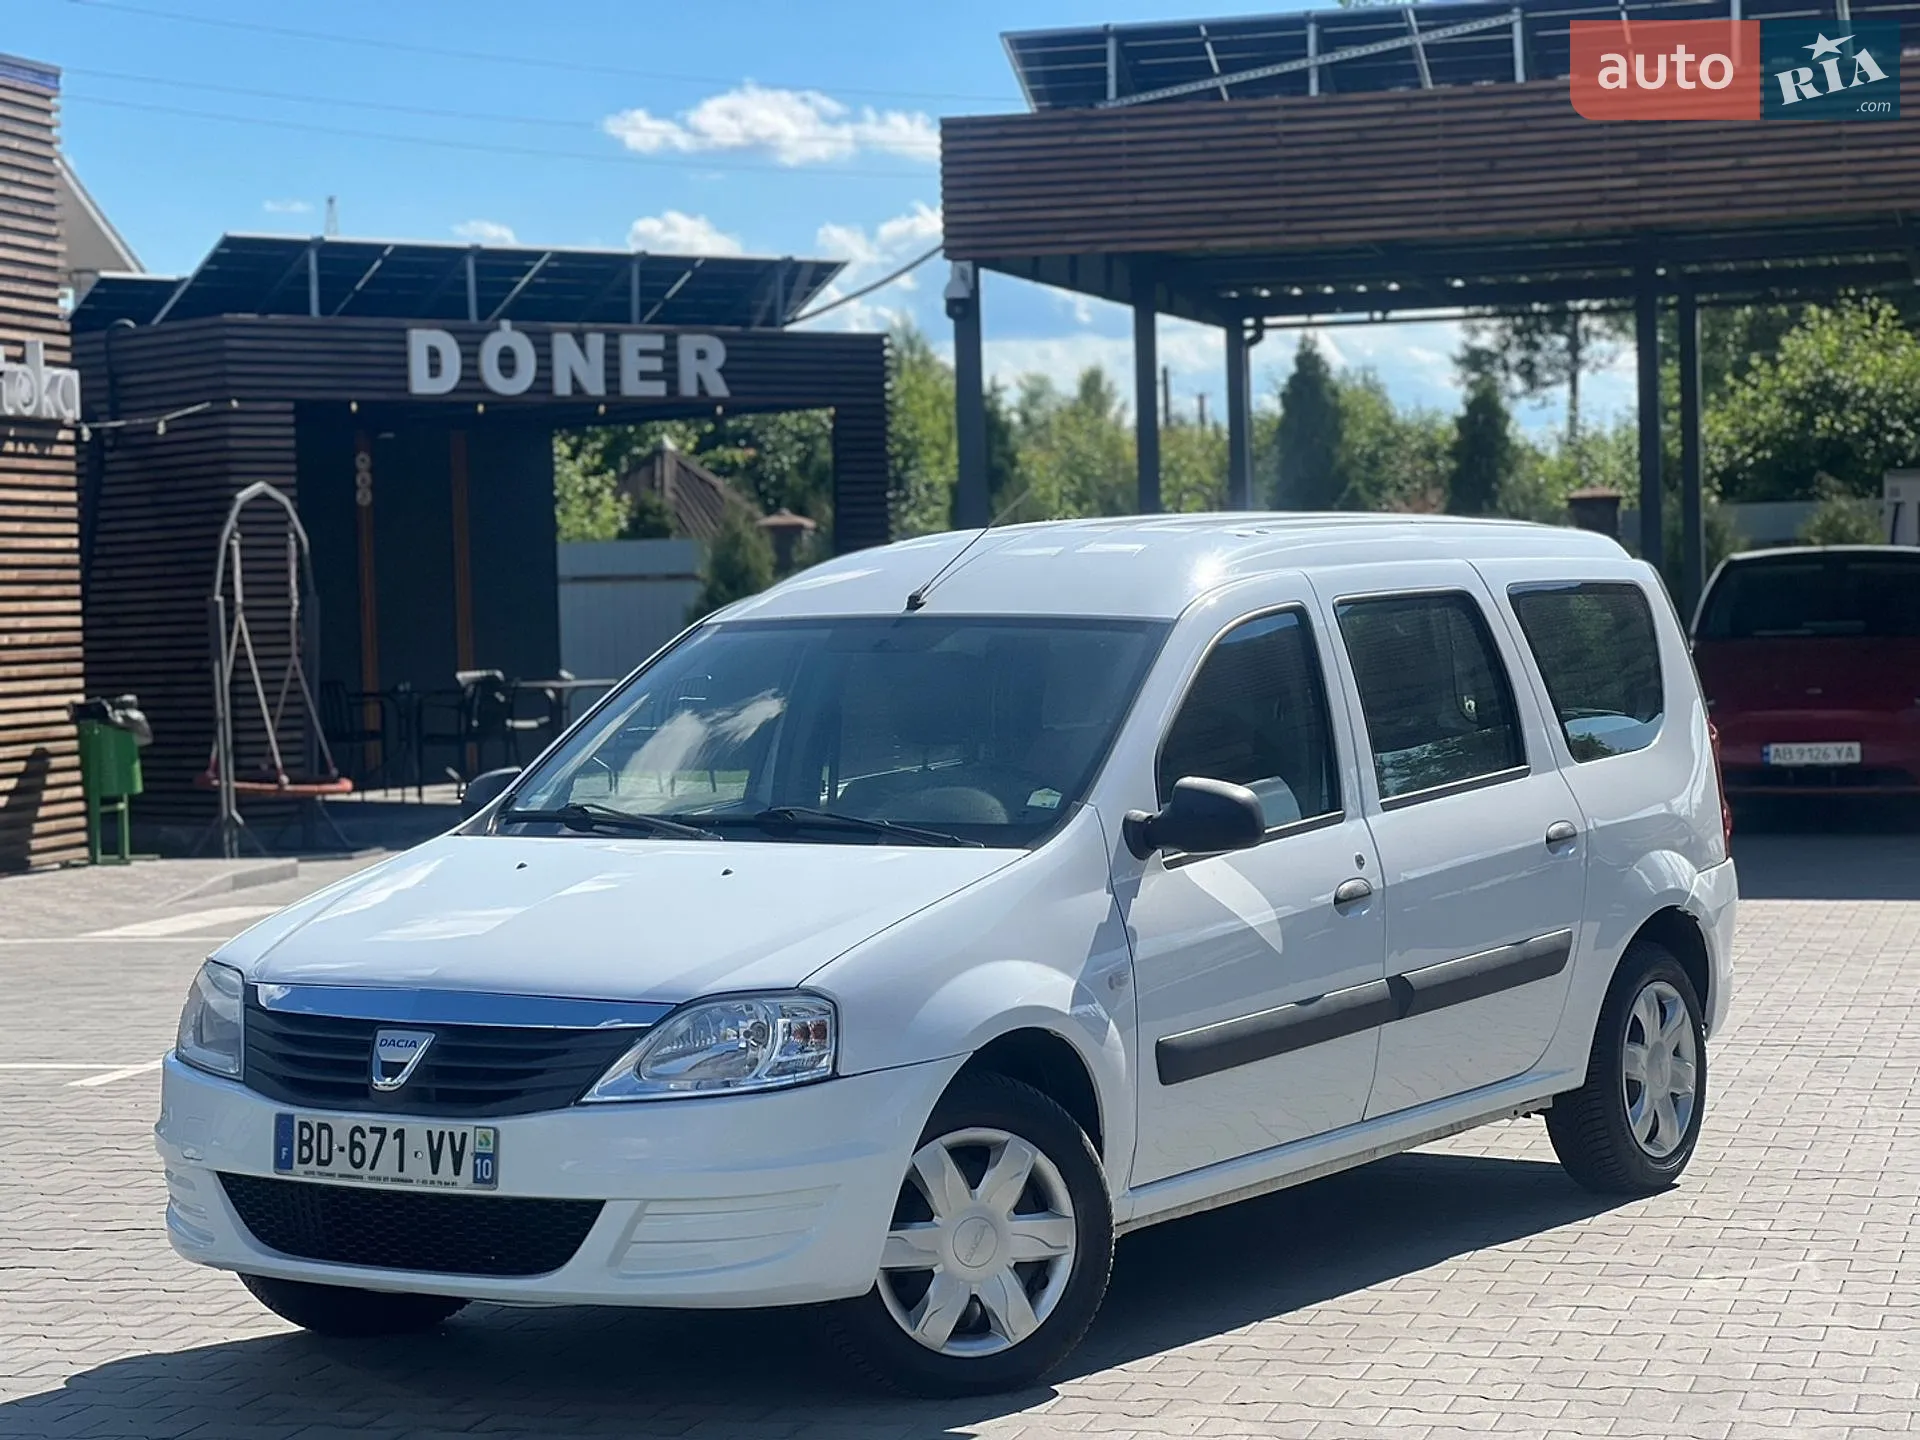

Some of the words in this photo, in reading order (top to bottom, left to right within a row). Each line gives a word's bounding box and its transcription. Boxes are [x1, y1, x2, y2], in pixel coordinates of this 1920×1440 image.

[379, 1039, 418, 1049] DACIA
[281, 1147, 289, 1160] F
[475, 1158, 492, 1179] 10
